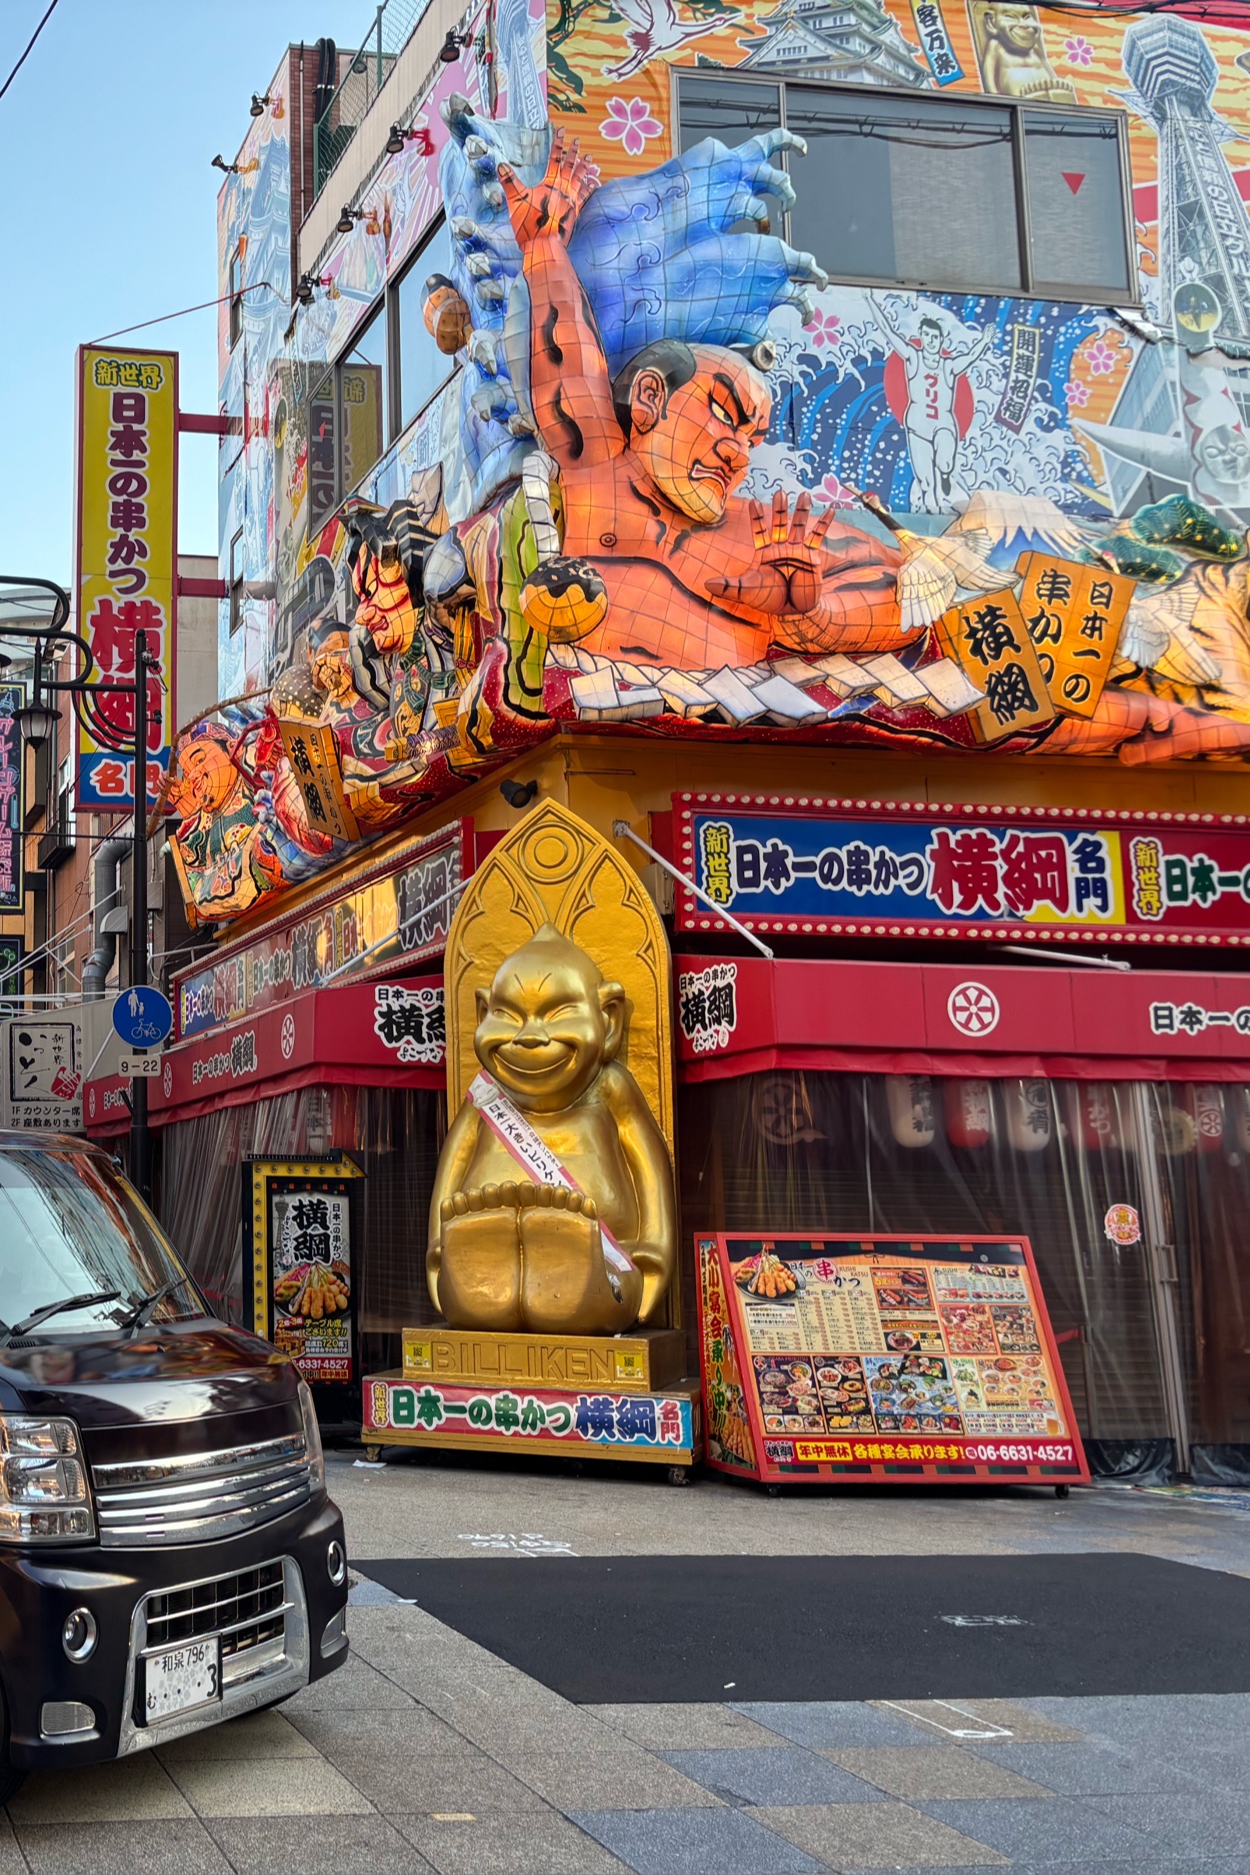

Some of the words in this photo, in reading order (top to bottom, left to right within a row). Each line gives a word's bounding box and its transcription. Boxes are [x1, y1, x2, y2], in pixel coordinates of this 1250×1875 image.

[915, 0, 958, 77] 客万来
[95, 360, 163, 389] 新世界
[923, 372, 940, 421] グリコ
[1002, 328, 1037, 424] 開運招福
[106, 392, 150, 595] 日本一の串かつ
[962, 606, 1039, 726] 横綱
[1064, 580, 1113, 704] 日本一の
[90, 599, 167, 752] 横綱
[90, 761, 168, 798] 名門
[702, 823, 733, 906] 新世界
[1071, 839, 1110, 914] 名門
[1133, 840, 1163, 917] 新世界
[1164, 856, 1250, 904] 日本一
[679, 964, 738, 989] 日本一の串かつ
[680, 984, 737, 1034] 横綱
[120, 1059, 160, 1074] 9-22
[11, 1105, 21, 1115] 1F
[23, 1105, 81, 1116] カウンター席
[11, 1118, 21, 1127] 2F
[23, 1117, 81, 1128] 座敷あります
[291, 1198, 332, 1264] 横綱
[332, 1203, 342, 1260] 日本一の串かつ
[305, 1318, 342, 1328] テーブル席
[430, 1340, 617, 1384] BILLIKEN
[374, 1382, 388, 1425] 新世界
[658, 1400, 681, 1443] 名門
[798, 1443, 851, 1459] 年中無休
[977, 1445, 1073, 1462] 06-6631-4527
[162, 1651, 184, 1673] 和泉
[185, 1644, 205, 1666] 796
